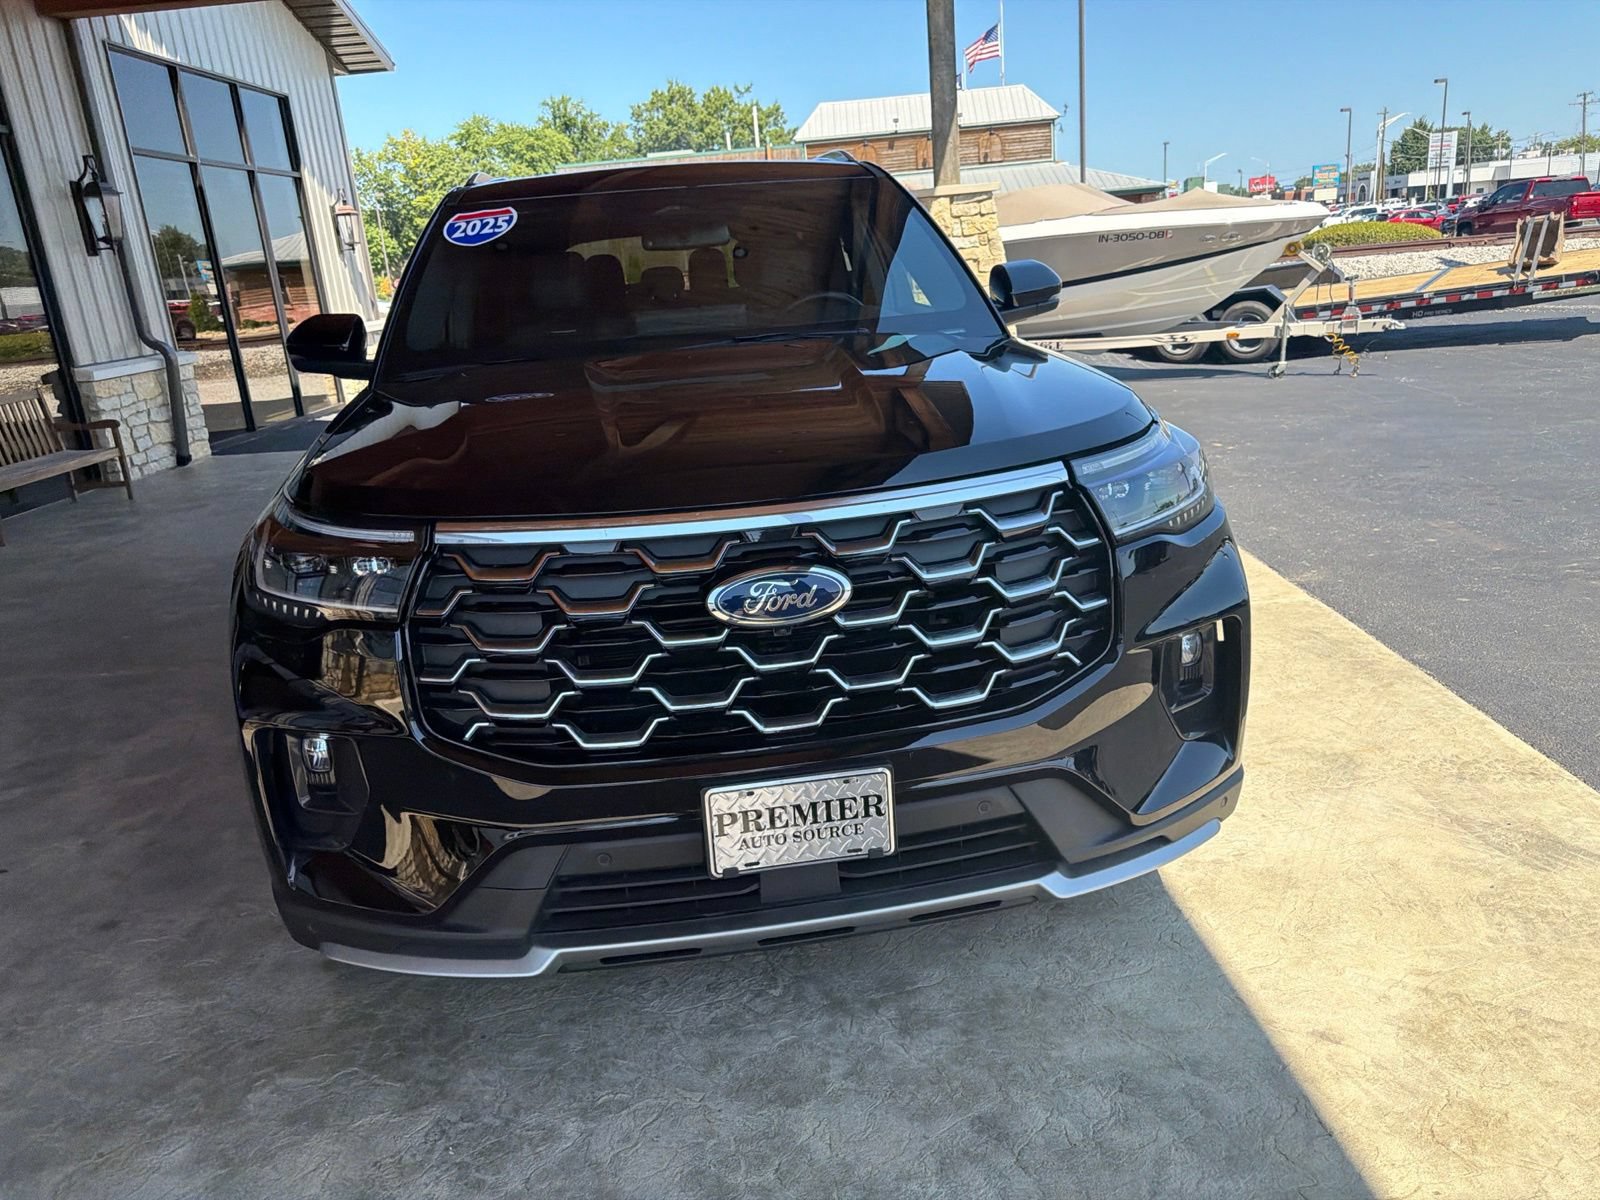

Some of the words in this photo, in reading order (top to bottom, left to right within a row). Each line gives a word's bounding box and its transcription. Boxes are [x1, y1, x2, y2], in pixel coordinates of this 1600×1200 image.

[451, 216, 510, 239] 2025
[743, 579, 818, 614] Ford
[714, 793, 886, 838] PREMIER
[739, 833, 787, 851] AUTO
[792, 822, 865, 844] SOURCE
